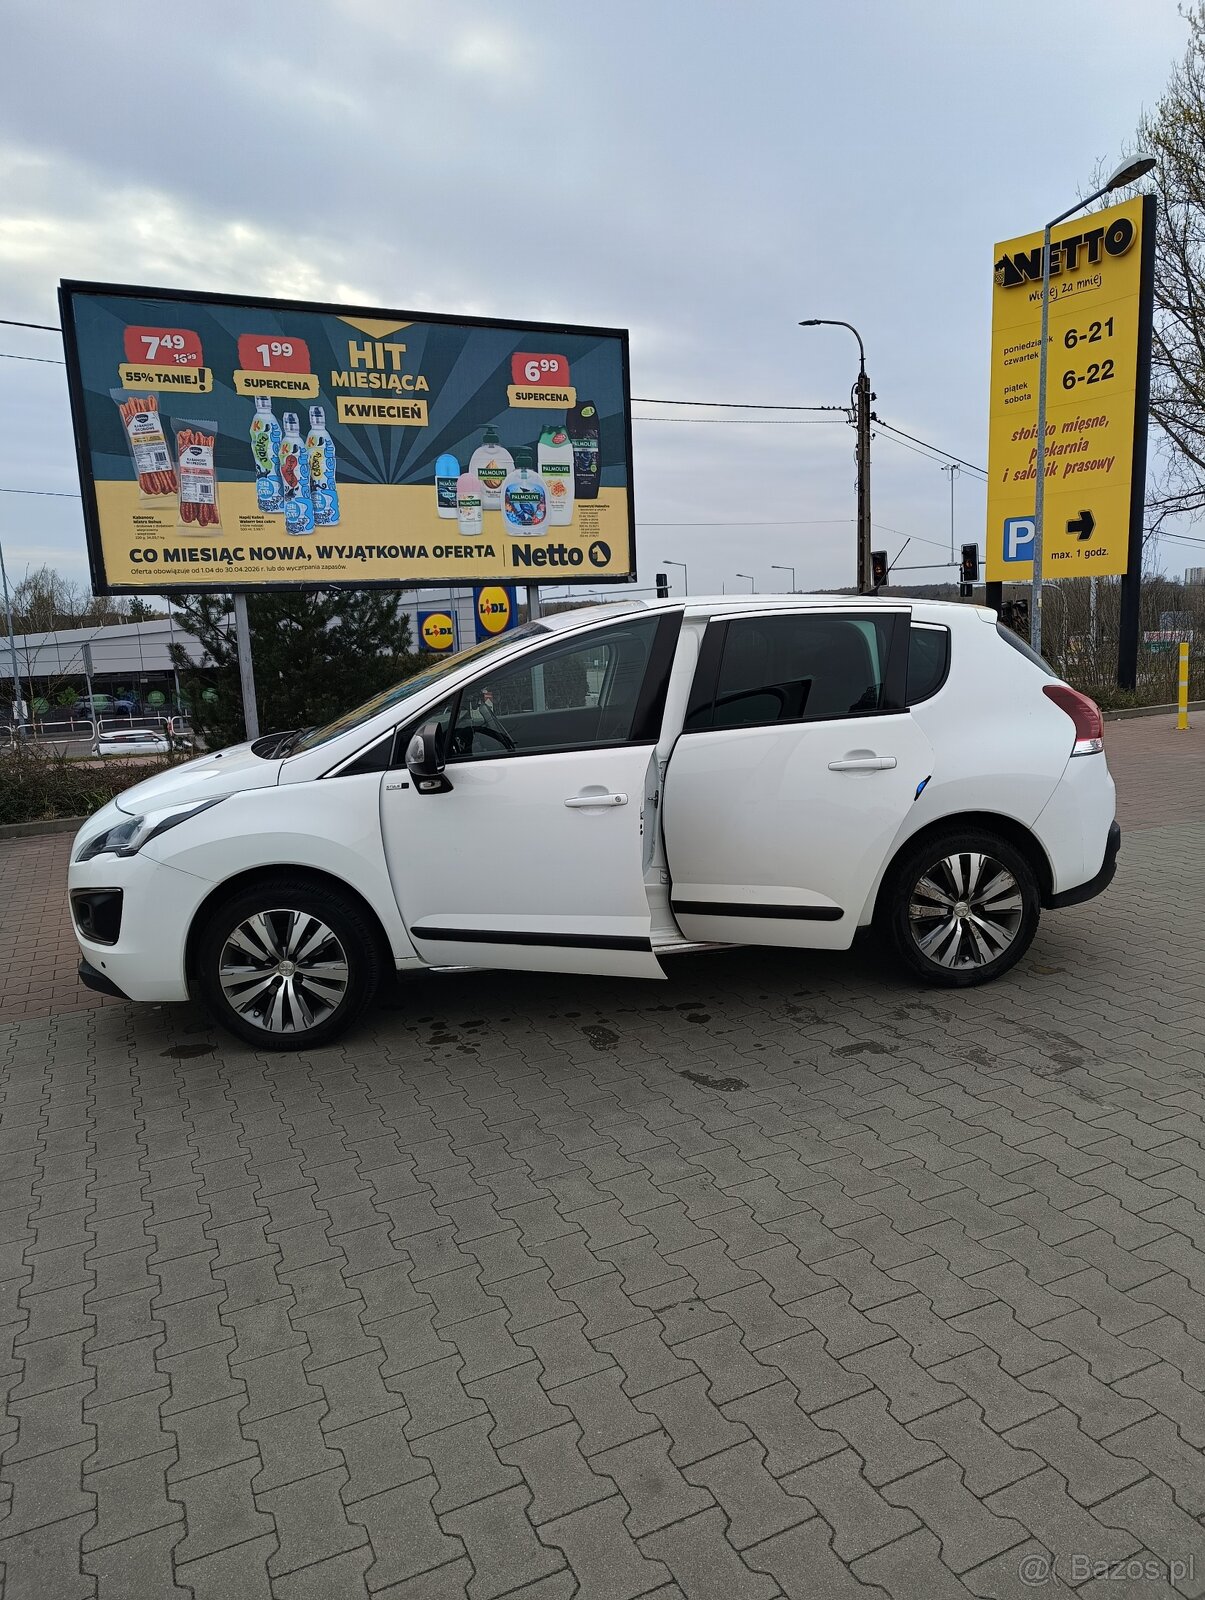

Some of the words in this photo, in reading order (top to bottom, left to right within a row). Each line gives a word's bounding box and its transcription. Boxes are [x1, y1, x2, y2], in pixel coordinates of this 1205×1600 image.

[1013, 217, 1136, 281] NETTO
[1029, 286, 1059, 302] Wiej
[1077, 271, 1102, 287] mniej
[1003, 335, 1054, 356] poniedziak
[1064, 316, 1114, 349] 6-21
[348, 339, 407, 371] HIT
[1003, 351, 1039, 366] czwartek
[125, 371, 154, 383] 55%
[154, 368, 206, 392] TANIEJ!
[243, 378, 311, 392] SUPERCENA
[331, 370, 430, 395] MIESIĄCA
[1062, 359, 1115, 390] 6-22
[515, 391, 570, 402] SUPERCENA
[1004, 381, 1028, 396] piątek
[1004, 392, 1032, 405] sobota
[344, 403, 422, 419] KWIECIEŃ
[1061, 415, 1110, 434] mięsne,
[1028, 437, 1090, 465] pekarnia
[1002, 468, 1010, 483] i
[1012, 460, 1058, 482] saloik
[1062, 456, 1116, 480] prasowy
[129, 548, 158, 563] CO
[162, 547, 246, 565] MIESIĄC
[249, 546, 312, 561] NOWA,
[315, 545, 429, 562] WYJĄTKOWA
[432, 545, 496, 559] OFERTA
[511, 543, 584, 567] Netto
[1051, 551, 1074, 560] max.
[1076, 549, 1082, 558] 1
[1085, 547, 1110, 560] godz.
[153, 567, 190, 576] obowiązuje
[191, 566, 200, 574] od
[225, 565, 260, 573] 30.04.2026
